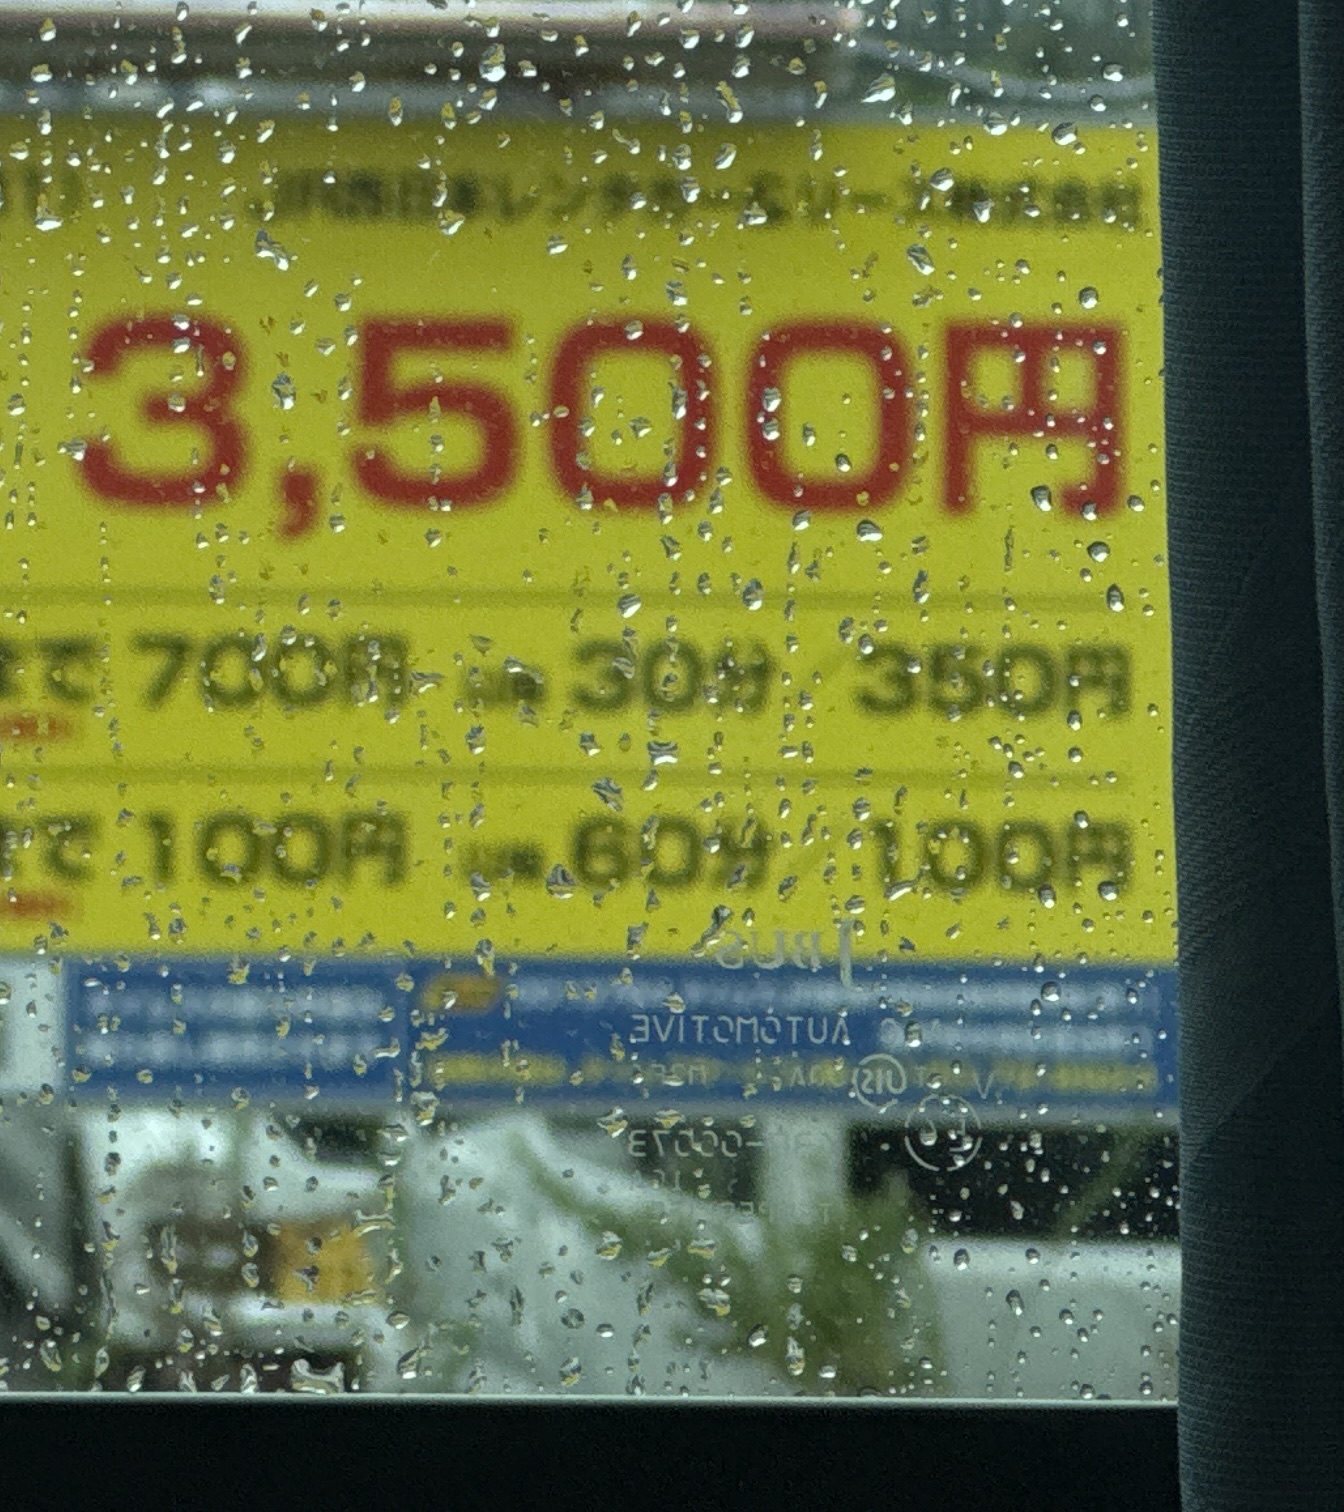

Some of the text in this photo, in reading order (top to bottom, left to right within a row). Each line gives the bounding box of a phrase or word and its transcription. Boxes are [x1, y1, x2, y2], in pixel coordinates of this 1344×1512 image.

[76, 310, 1128, 541] 3,500円
[129, 632, 410, 716] 700円
[855, 638, 1132, 723] 350円
[143, 810, 410, 890] 100円
[869, 814, 1132, 894] 100円
